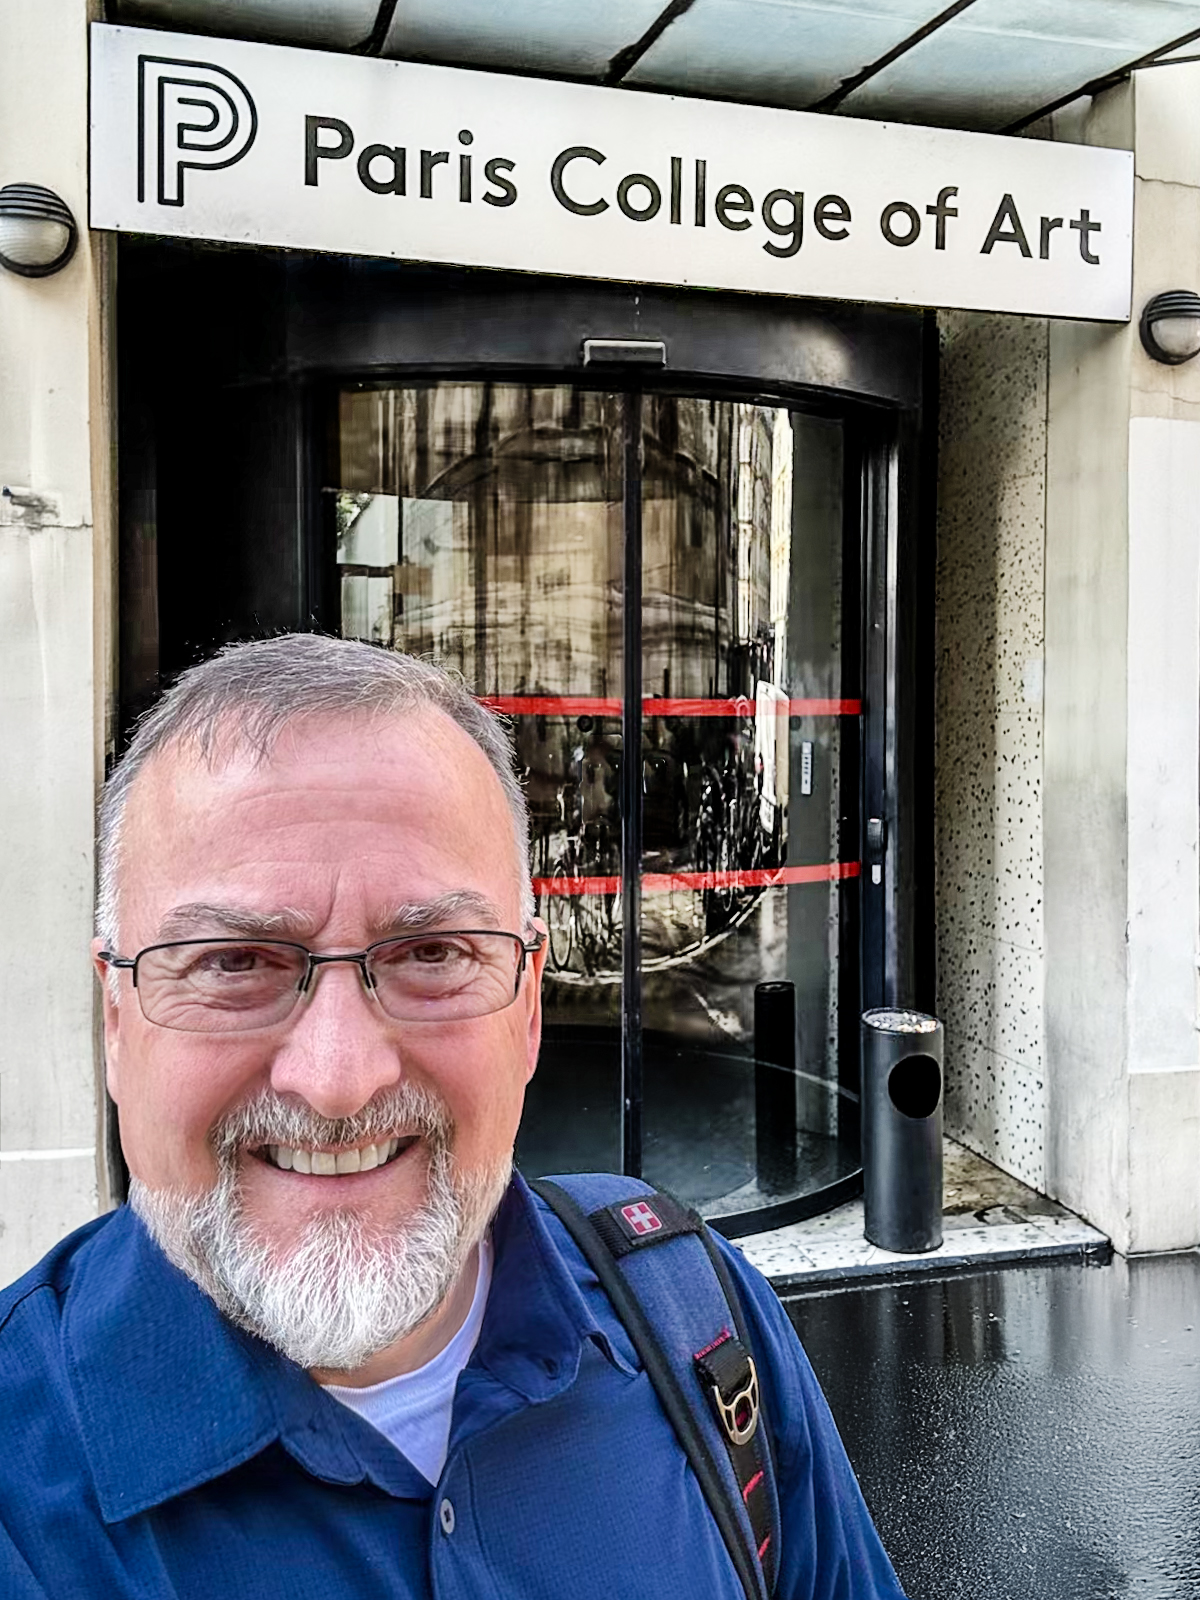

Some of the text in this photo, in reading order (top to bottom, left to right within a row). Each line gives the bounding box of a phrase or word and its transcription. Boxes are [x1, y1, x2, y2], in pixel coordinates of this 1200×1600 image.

[305, 115, 1101, 264] Paris College of Art
